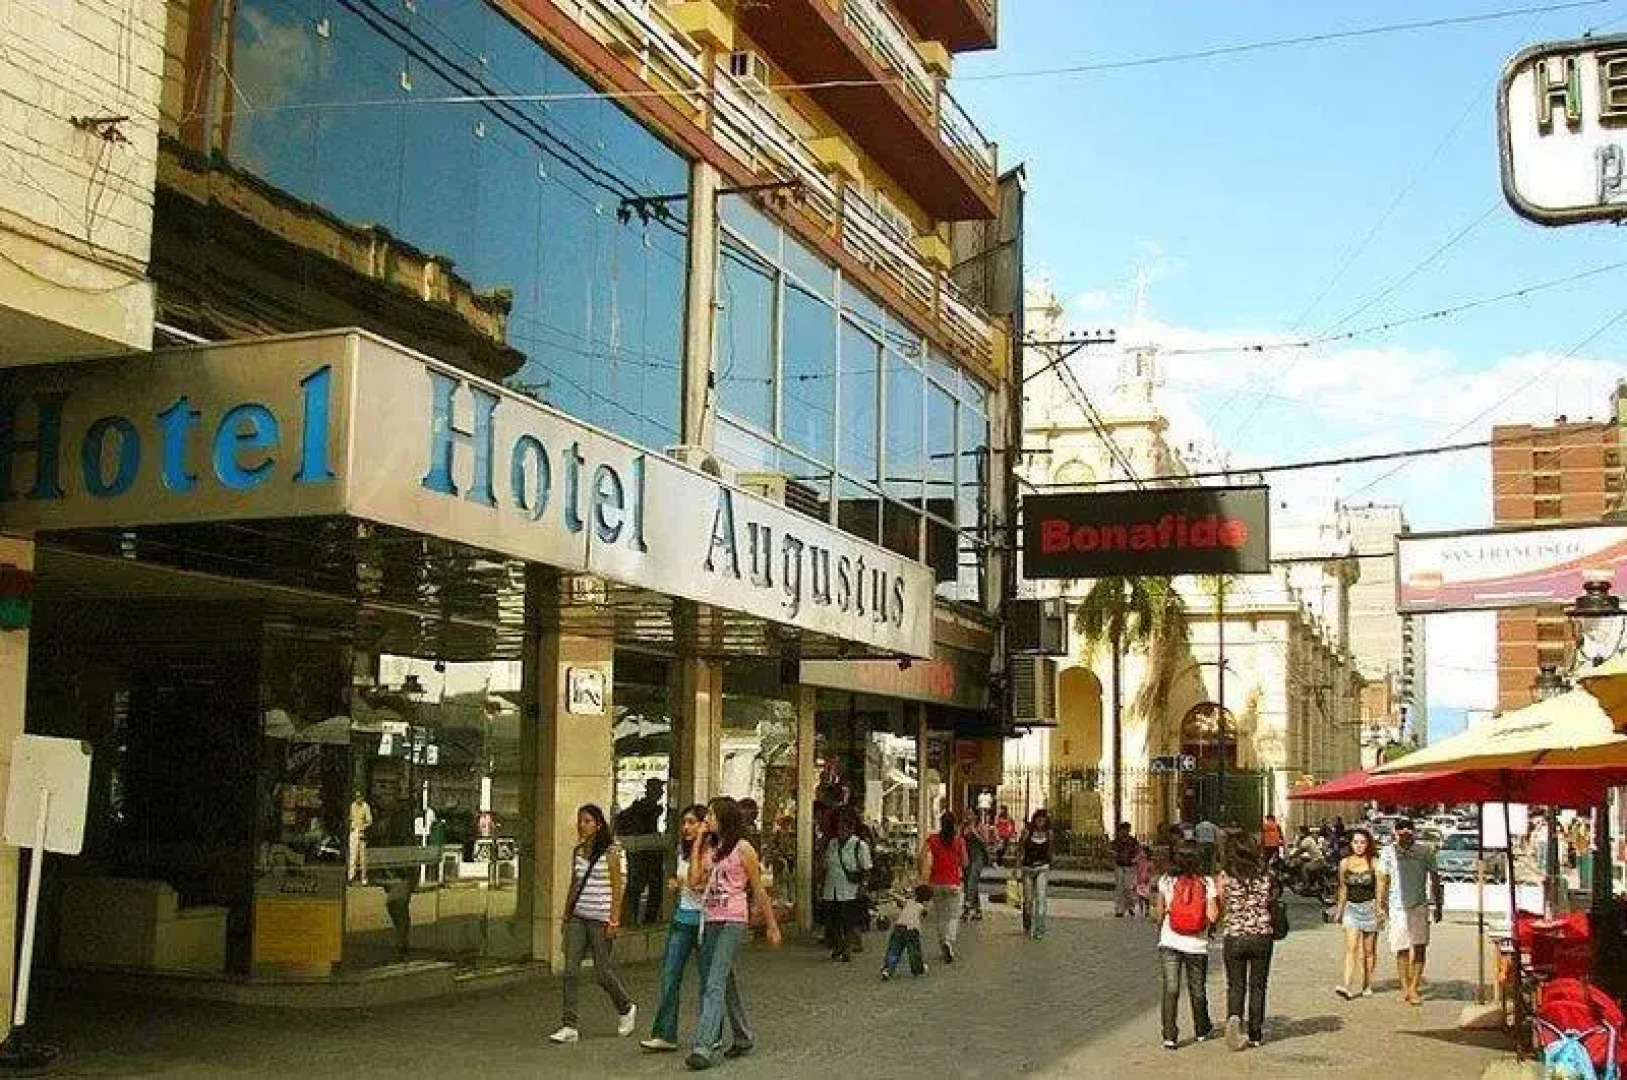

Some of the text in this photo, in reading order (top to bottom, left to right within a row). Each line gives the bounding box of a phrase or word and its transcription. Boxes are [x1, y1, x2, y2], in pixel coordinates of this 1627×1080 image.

[0, 364, 338, 502] Hotel
[421, 366, 907, 630] Hotel Augustus
[1040, 513, 1248, 553] Bonafide
